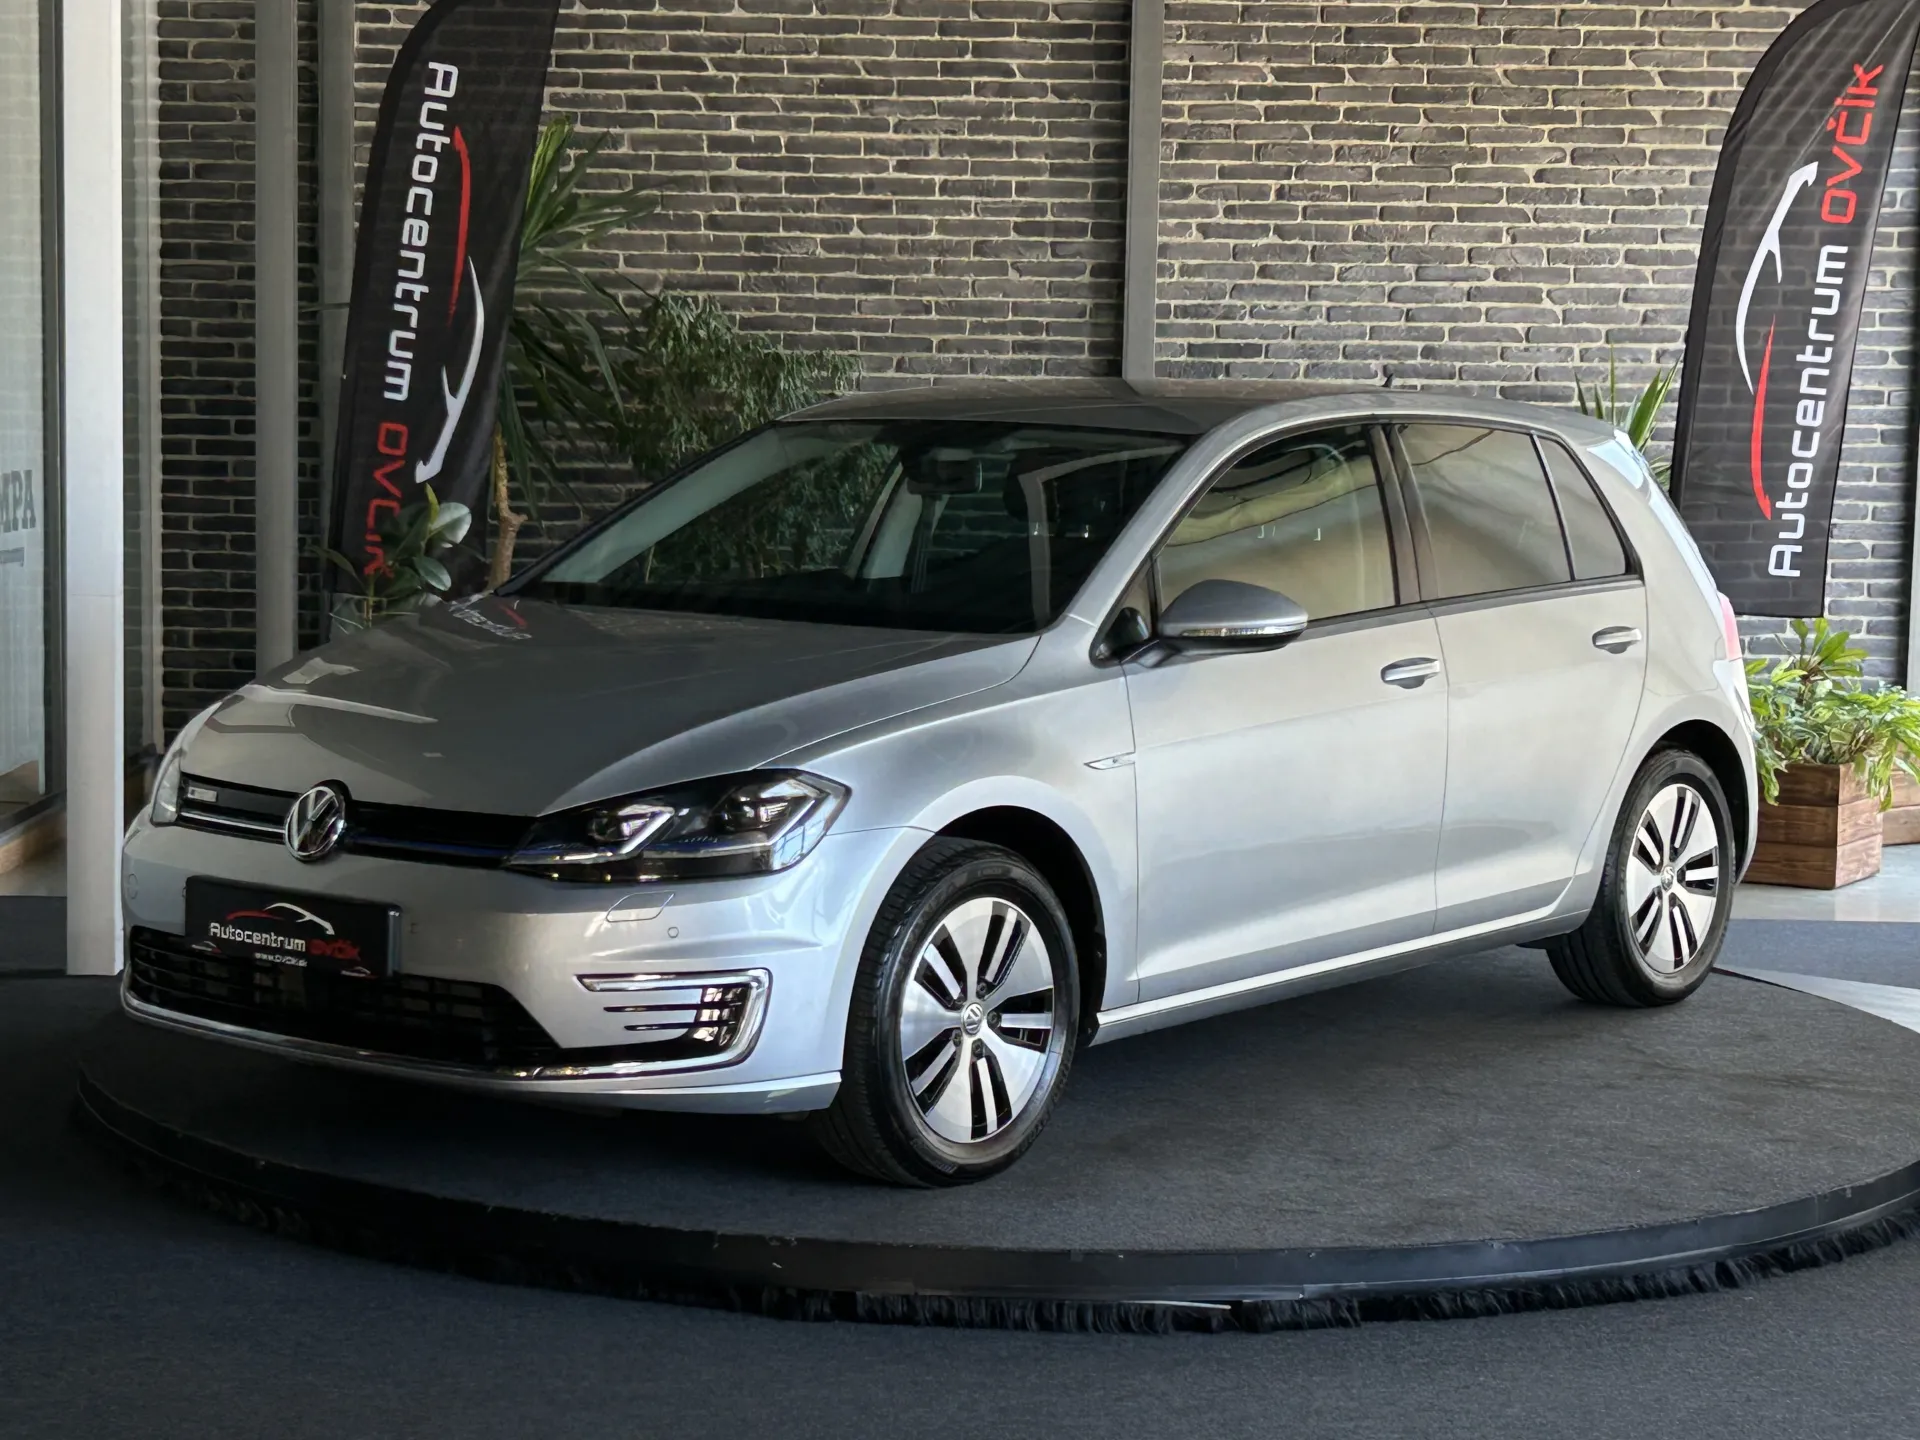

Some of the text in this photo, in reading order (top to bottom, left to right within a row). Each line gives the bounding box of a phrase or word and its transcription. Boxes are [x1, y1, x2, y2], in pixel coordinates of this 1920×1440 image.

[383, 61, 459, 402] Autocentrum
[1767, 244, 1849, 578] Autocentrum
[208, 921, 306, 952] Autocentrum
